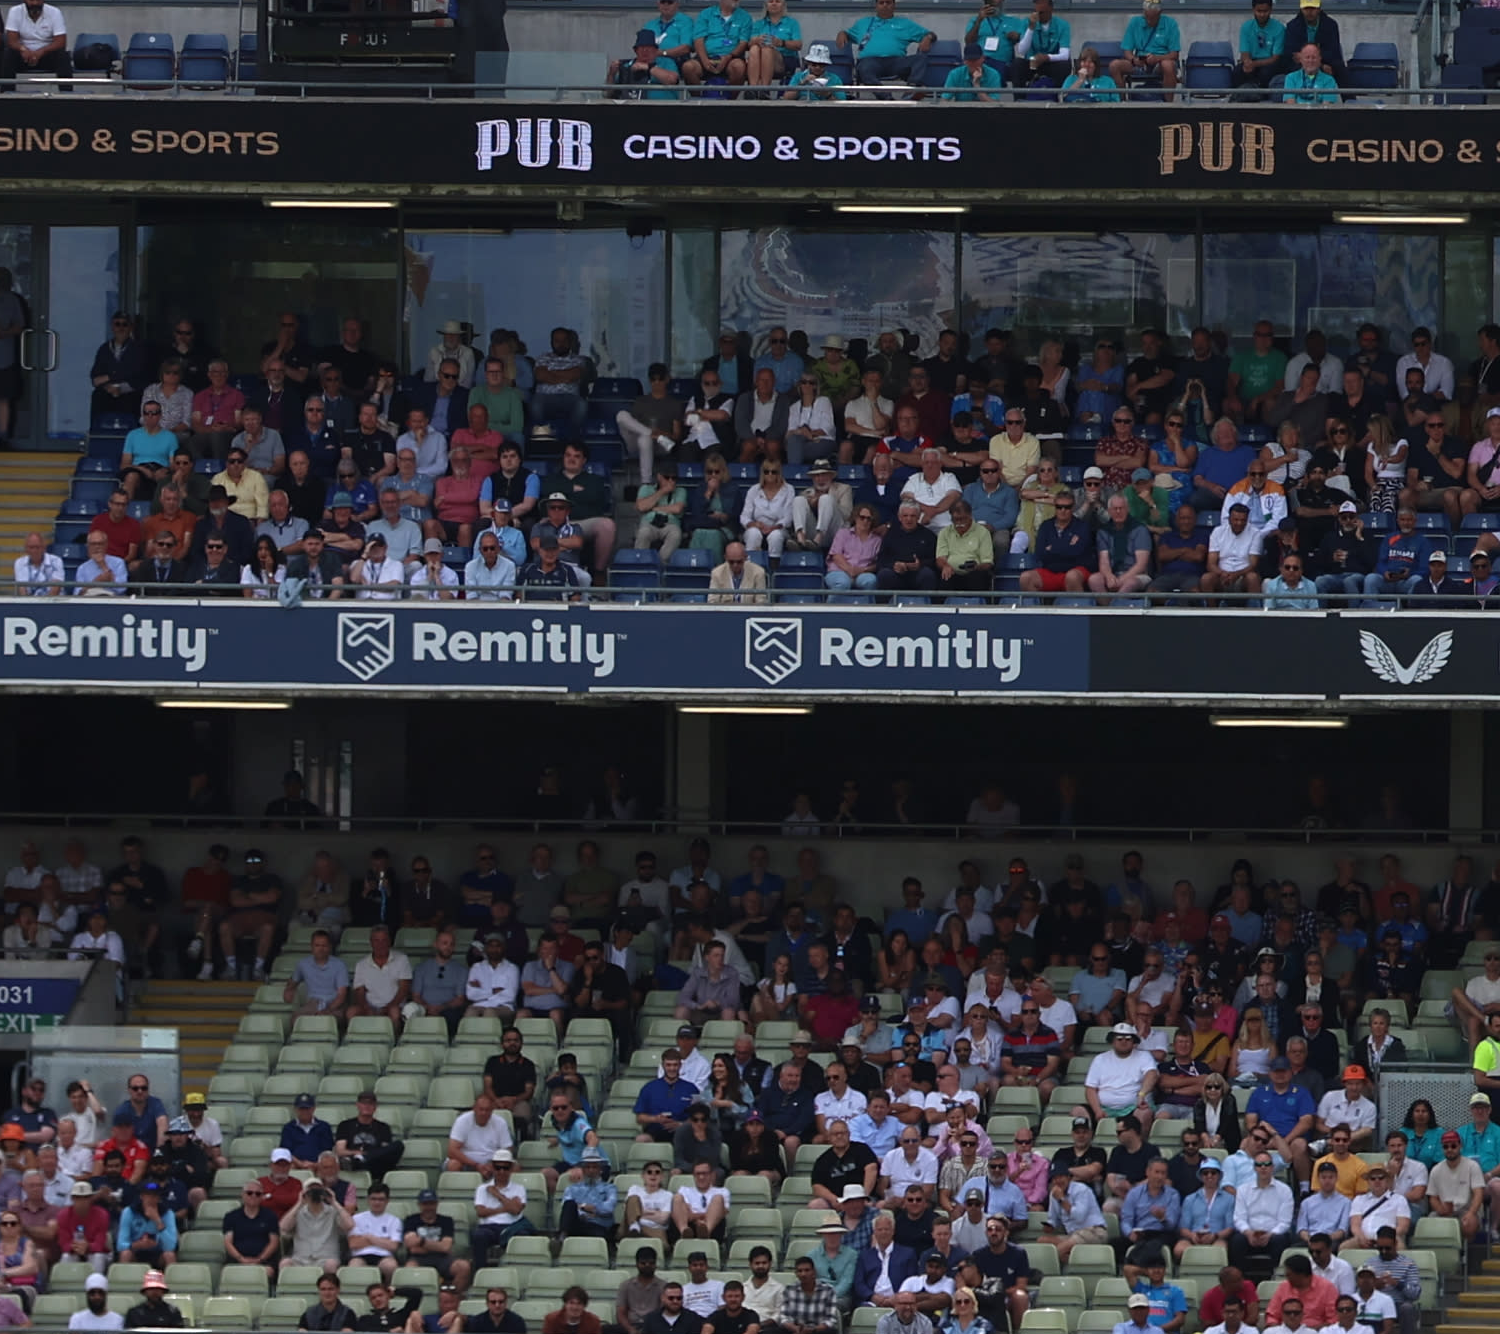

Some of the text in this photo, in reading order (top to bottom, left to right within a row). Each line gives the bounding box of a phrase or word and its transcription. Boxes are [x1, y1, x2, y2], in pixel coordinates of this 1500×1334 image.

[92, 129, 116, 152] &
[132, 130, 279, 155] SPORTS
[475, 118, 961, 171] PUB CASINO & SPORTS
[1158, 122, 1274, 175] PUB
[1307, 139, 1443, 163] CASINO
[1457, 140, 1481, 163] &
[4, 614, 206, 671] Remitly
[414, 619, 614, 676] Remitly
[820, 624, 1020, 682] Remitly
